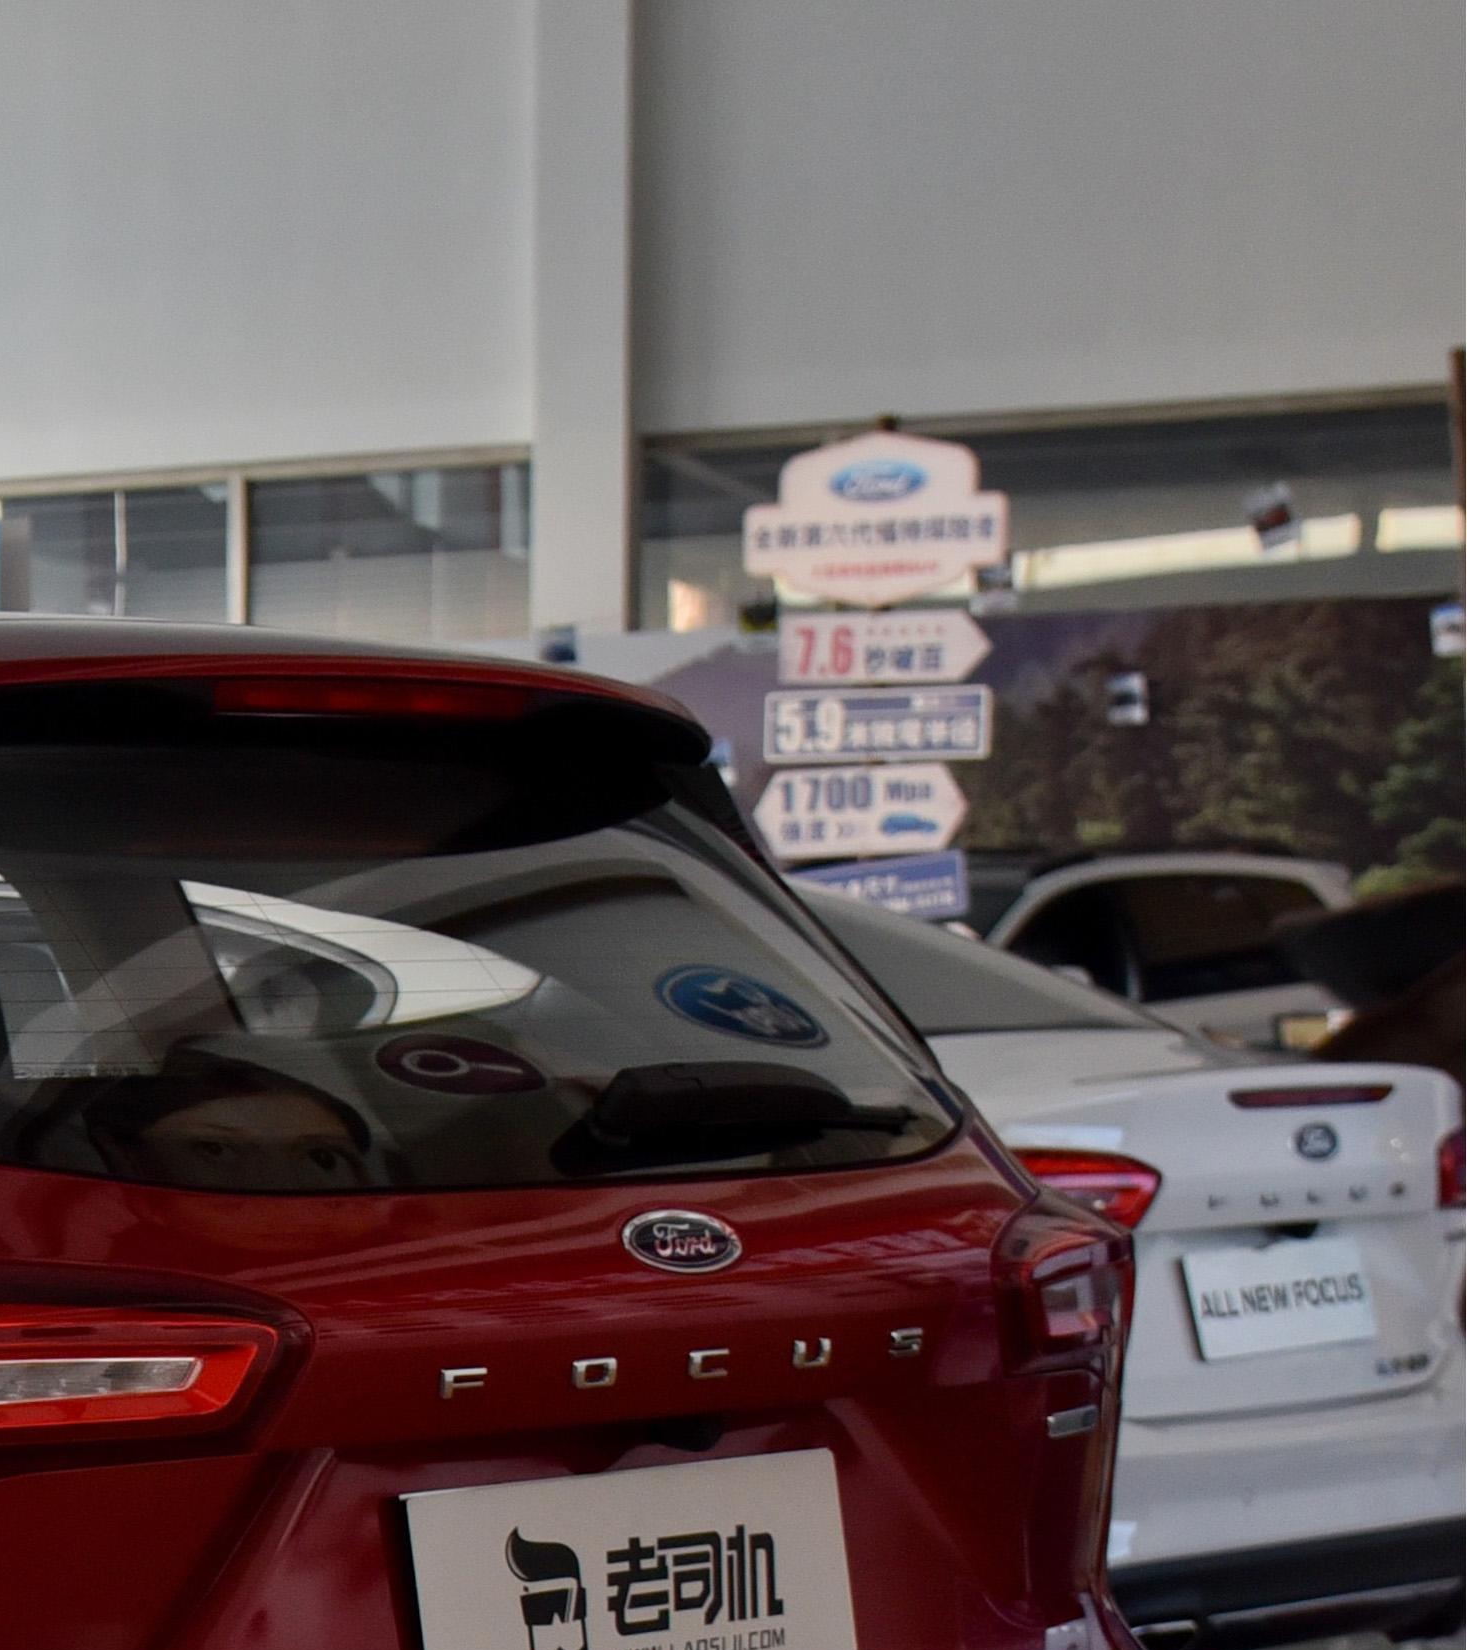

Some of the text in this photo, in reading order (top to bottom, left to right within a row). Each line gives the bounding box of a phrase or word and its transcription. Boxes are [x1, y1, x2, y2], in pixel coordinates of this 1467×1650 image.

[796, 625, 855, 676] 7.6
[775, 698, 846, 752] 5.9
[650, 1219, 721, 1260] Ford
[1200, 1271, 1365, 1319] ALL NEW FOCUS
[439, 1327, 924, 1400] FOCUS
[605, 1523, 785, 1636] 老司机
